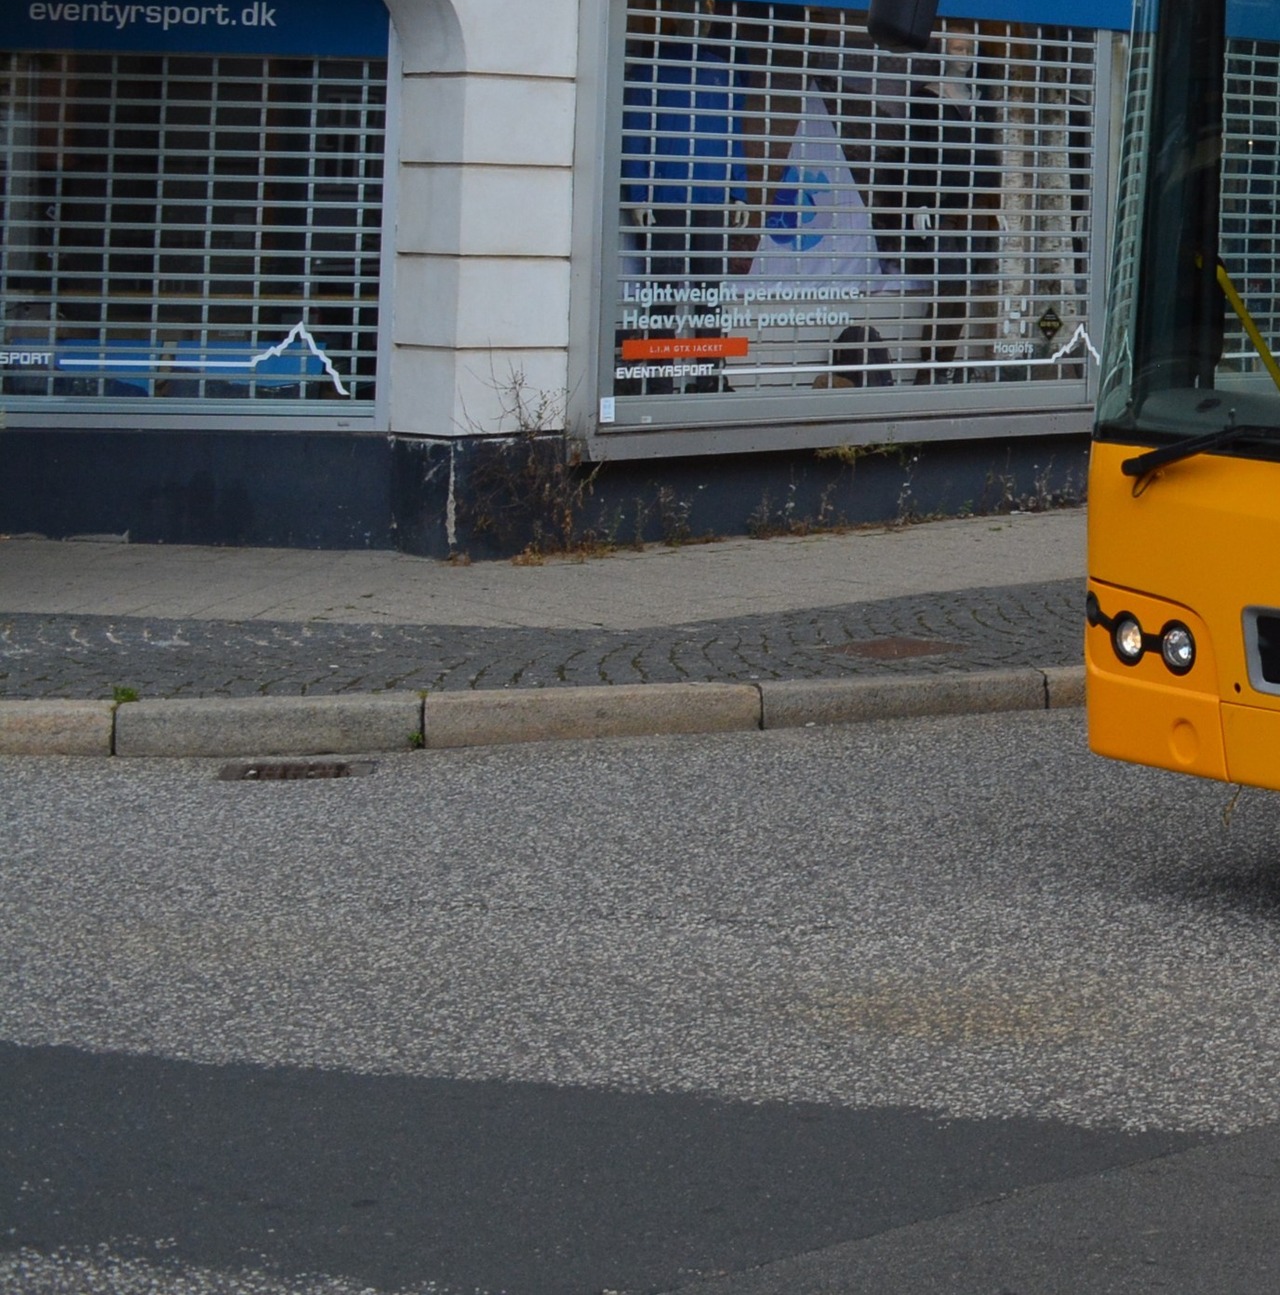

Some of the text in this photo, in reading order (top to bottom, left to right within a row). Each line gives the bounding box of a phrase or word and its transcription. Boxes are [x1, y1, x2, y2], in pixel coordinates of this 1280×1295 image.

[29, 0, 277, 31] eventyrsport.dk
[623, 282, 865, 307] Lightweight performance.
[622, 308, 854, 333] Heavyweight protection.
[693, 344, 723, 353] JACKET
[616, 364, 715, 379] EVENTYRSPORT
